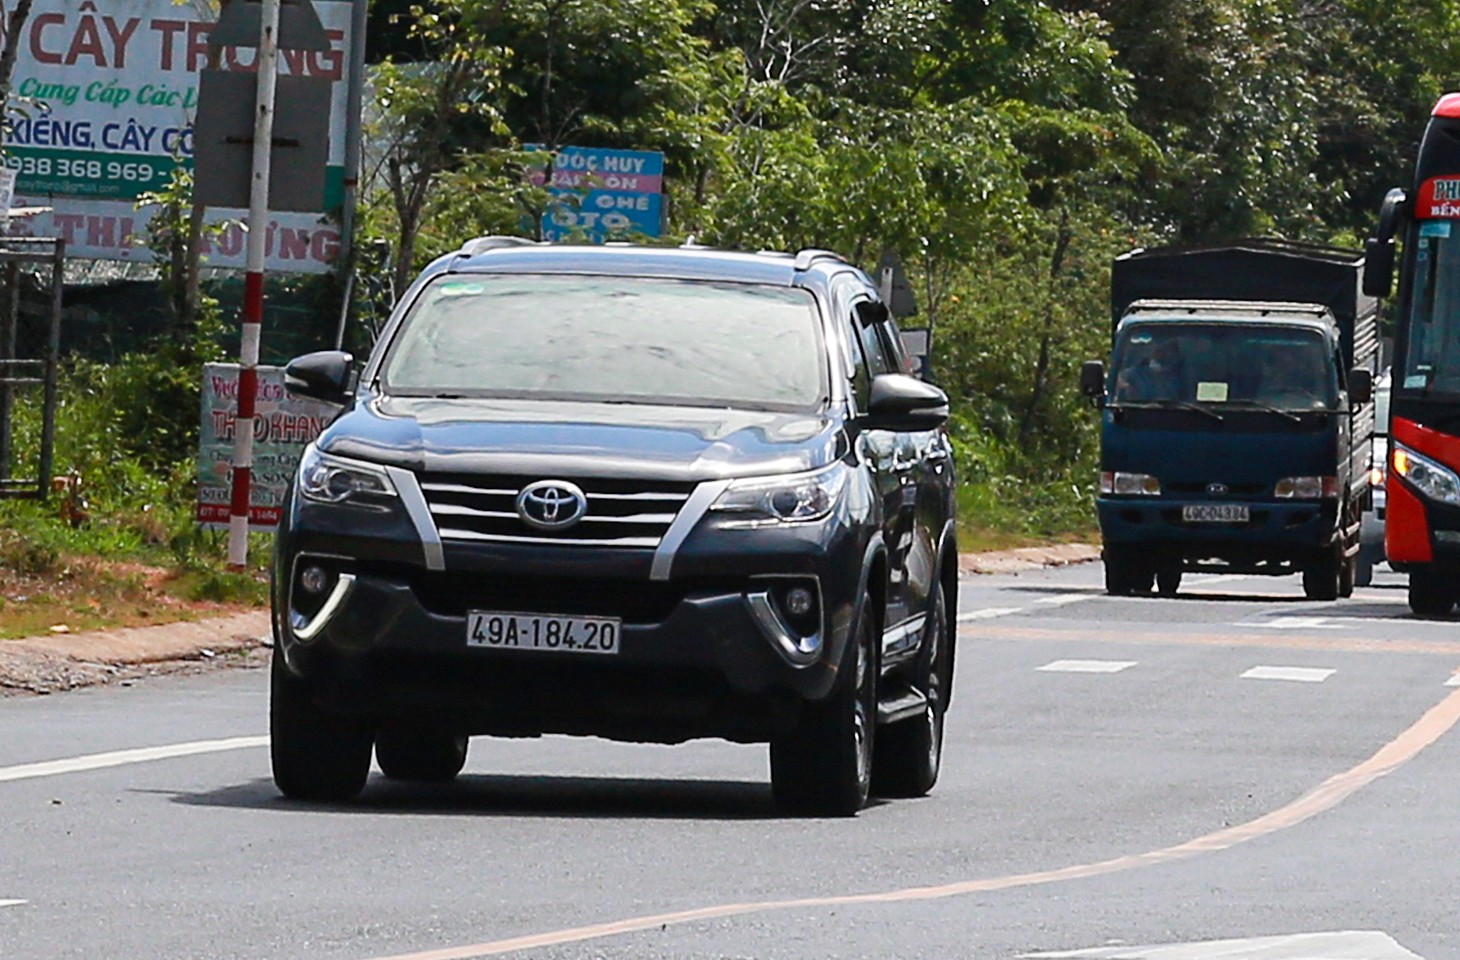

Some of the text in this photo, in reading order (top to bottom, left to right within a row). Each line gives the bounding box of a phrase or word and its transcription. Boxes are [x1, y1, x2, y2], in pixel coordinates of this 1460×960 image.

[29, 0, 142, 69] CÂY
[20, 77, 79, 106] Cung
[85, 77, 130, 110] Cấp
[101, 117, 157, 152] CÂY
[56, 158, 102, 178] 368
[106, 161, 153, 182] 969
[1431, 201, 1454, 217] BẾN
[471, 615, 616, 651] 49A-184.20
